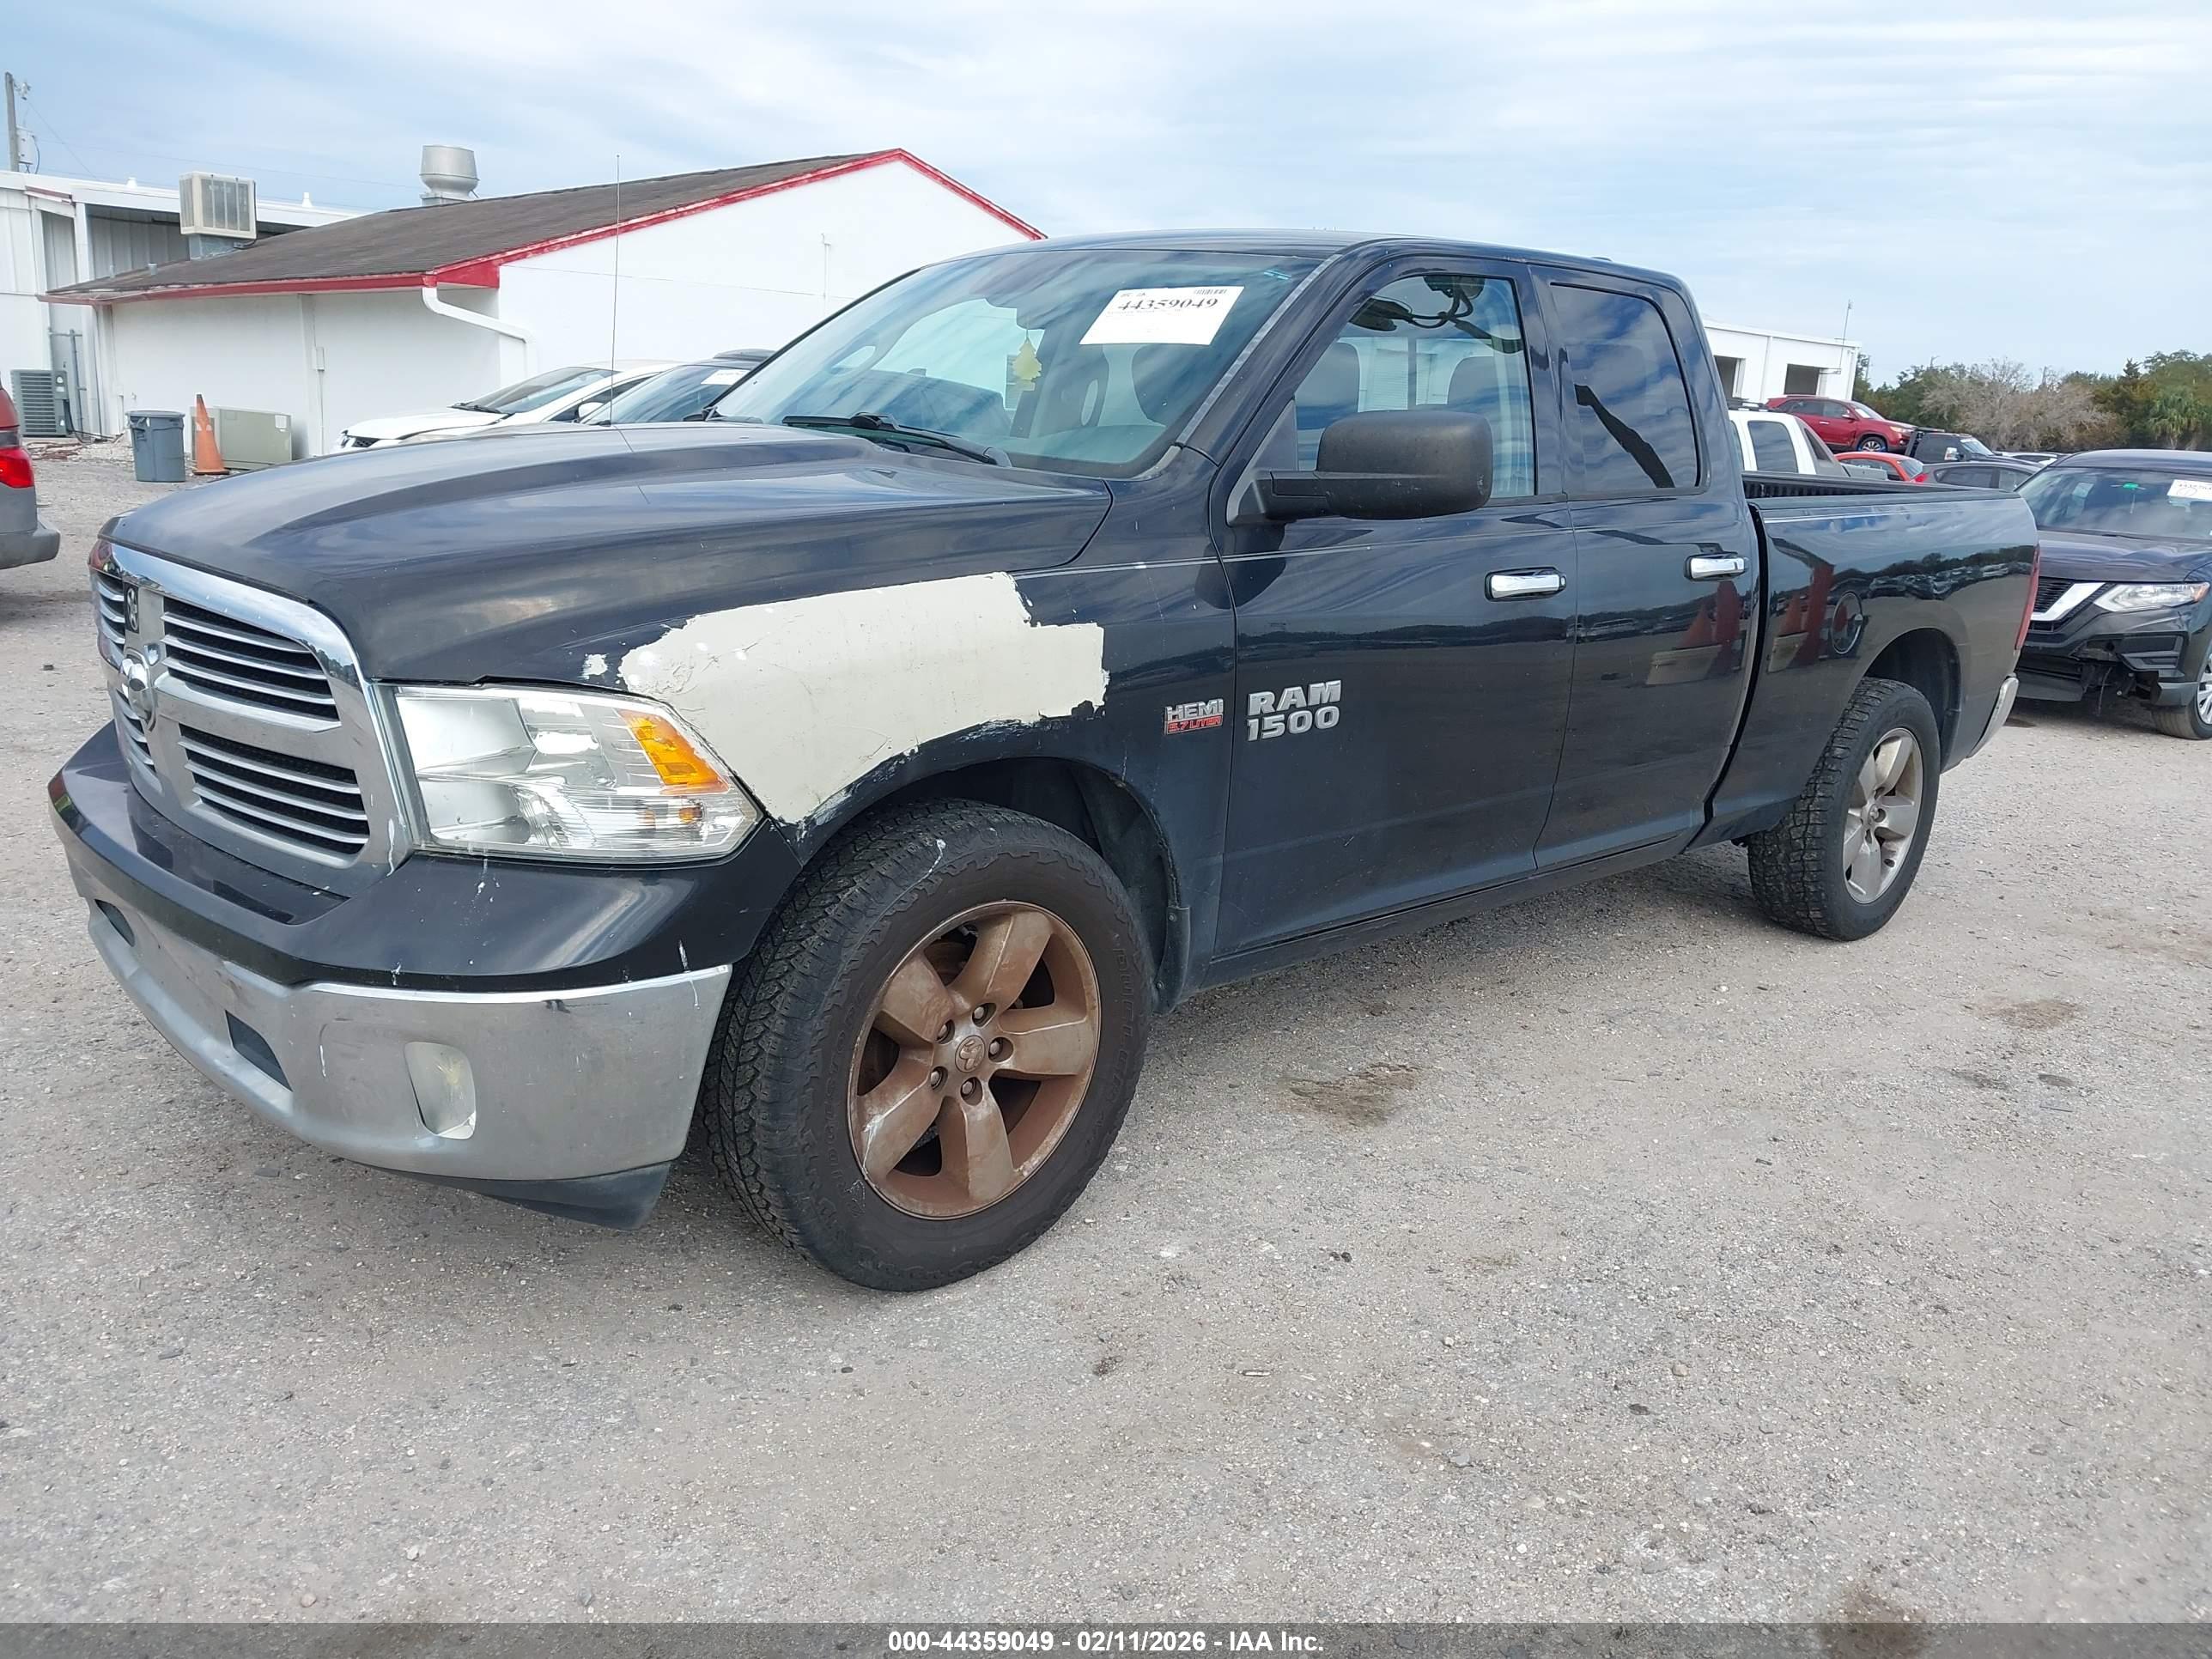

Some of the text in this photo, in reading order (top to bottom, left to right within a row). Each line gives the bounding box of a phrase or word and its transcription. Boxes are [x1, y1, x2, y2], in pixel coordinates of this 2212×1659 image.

[1119, 298, 1218, 310] 44359049
[1248, 679, 1342, 716] RAM
[1165, 698, 1224, 721] HEMI
[1167, 715, 1223, 732] 5.7 LITER
[1247, 705, 1340, 742] 1500
